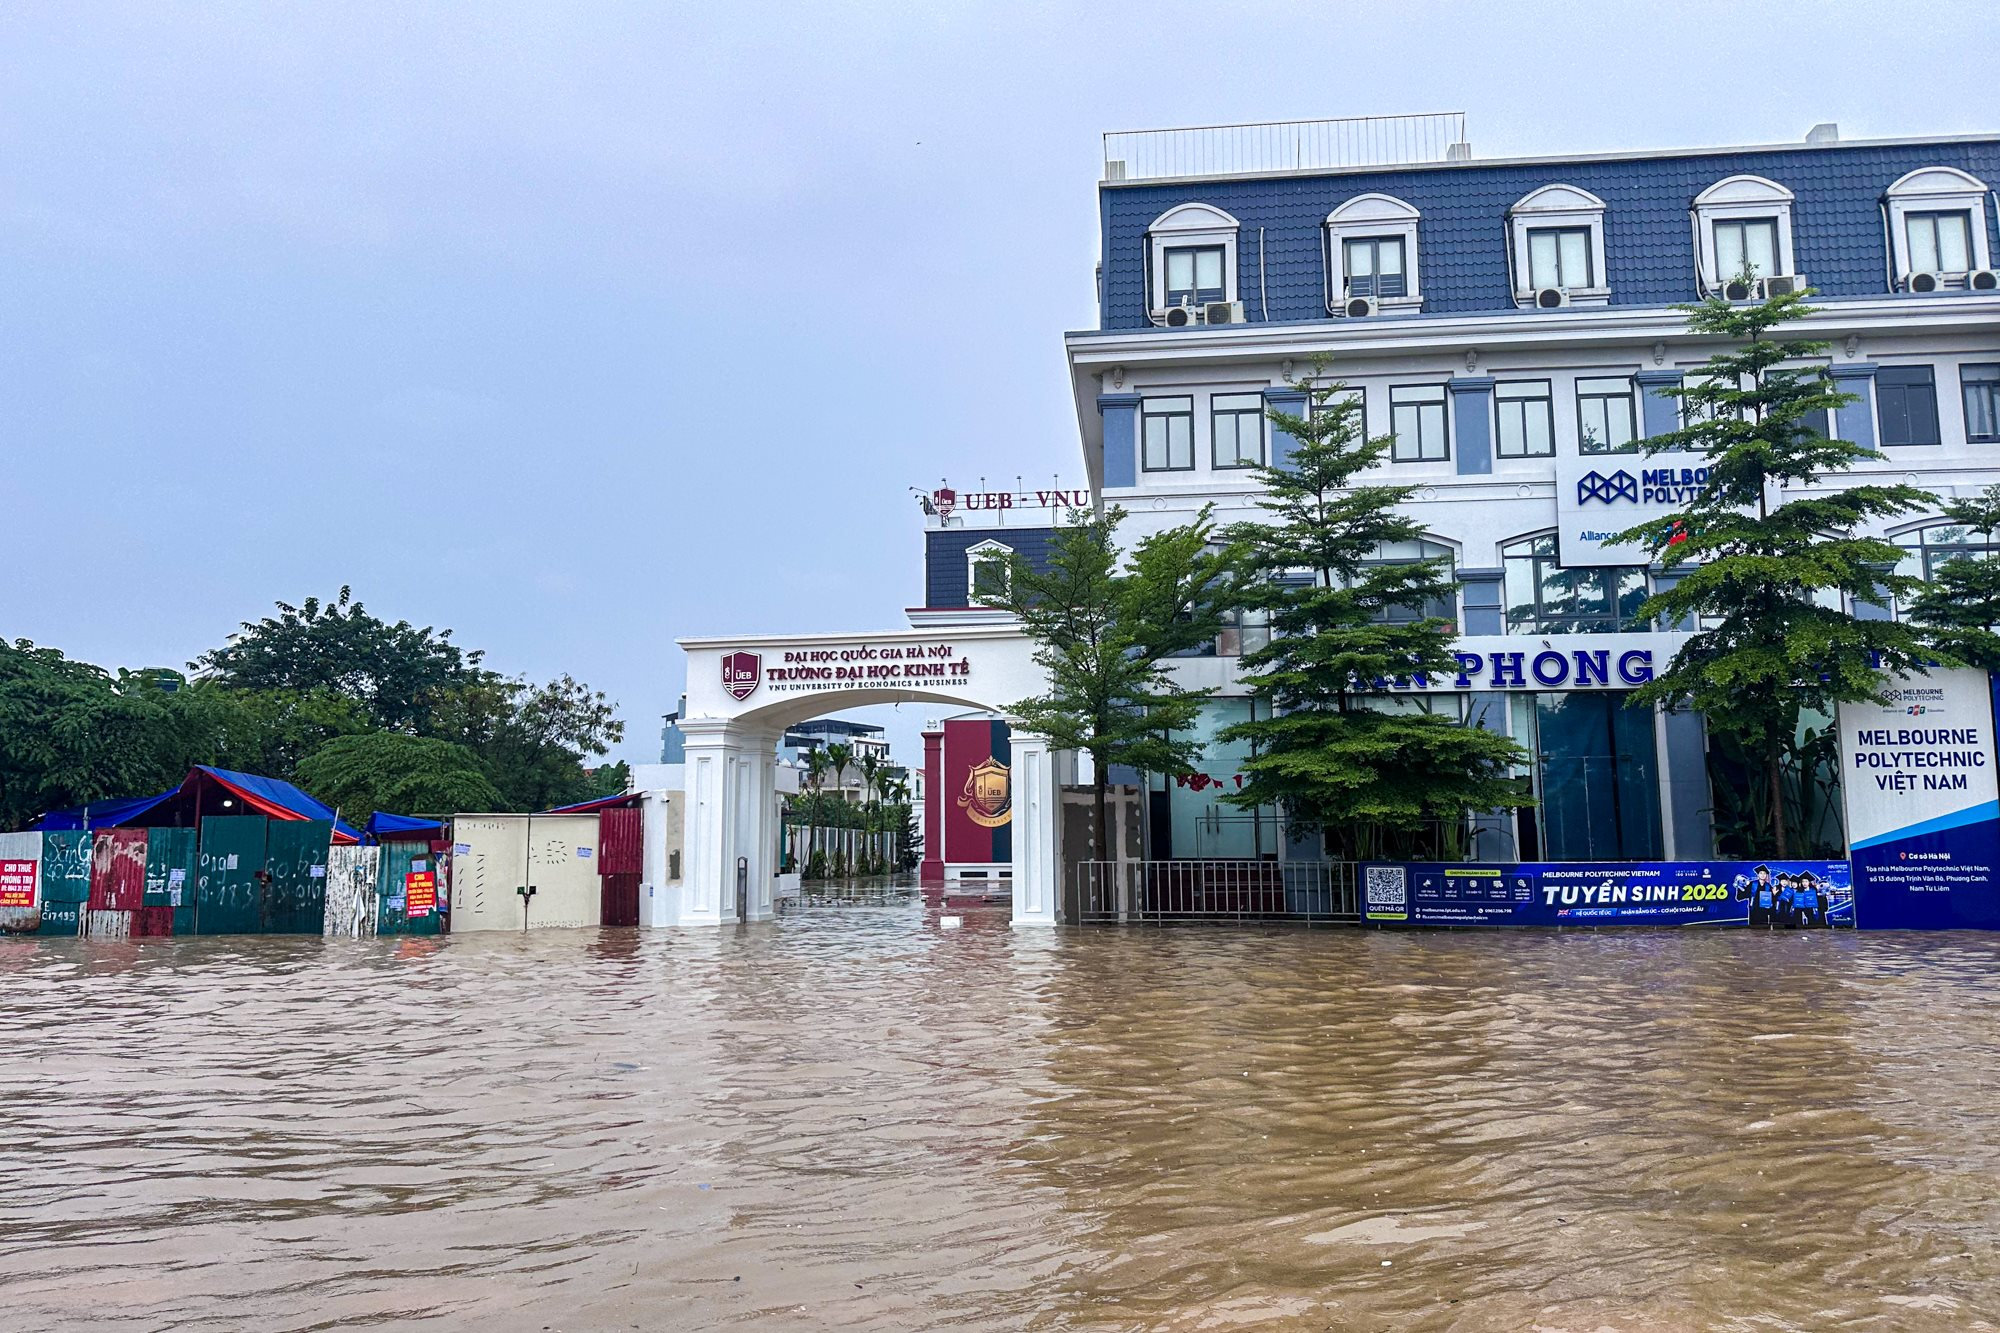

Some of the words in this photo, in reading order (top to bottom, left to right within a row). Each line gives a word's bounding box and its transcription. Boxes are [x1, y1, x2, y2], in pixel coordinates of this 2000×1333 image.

[1643, 468, 1714, 486] MELBO
[964, 493, 1013, 510] UEB
[1036, 490, 1090, 508] VNU
[784, 652, 808, 663] ĐẠI
[810, 651, 839, 664] HỌC
[841, 645, 878, 661] QUỐC
[880, 649, 904, 660] GIA
[906, 645, 925, 659] HÀ
[928, 644, 953, 659] NỘI
[767, 664, 833, 681] TRƯỜNG
[835, 665, 865, 681] ĐẠI
[867, 664, 901, 680] HỌC
[903, 663, 947, 677] KINH
[948, 656, 970, 676] TẾ
[1453, 640, 1654, 687] PHÒNG
[735, 671, 752, 680] UEB
[769, 684, 788, 692] VNU
[789, 683, 842, 691] UNIVERSITY
[858, 681, 913, 689] ECONOMICS
[923, 679, 968, 687] BUSINESS
[1858, 729, 1978, 746] MELBOURNE
[1855, 751, 1985, 768] POLYTECHNIC
[1875, 770, 1918, 795] VIỆT
[1923, 774, 1968, 790] NAM
[1923, 865, 1960, 873] Polytechnic
[1960, 865, 1973, 873] Việt
[1543, 879, 1627, 905] TUYỂN
[1631, 885, 1680, 901] SINH
[1681, 884, 1729, 901] 2026
[1369, 904, 1385, 912] QUÉT
